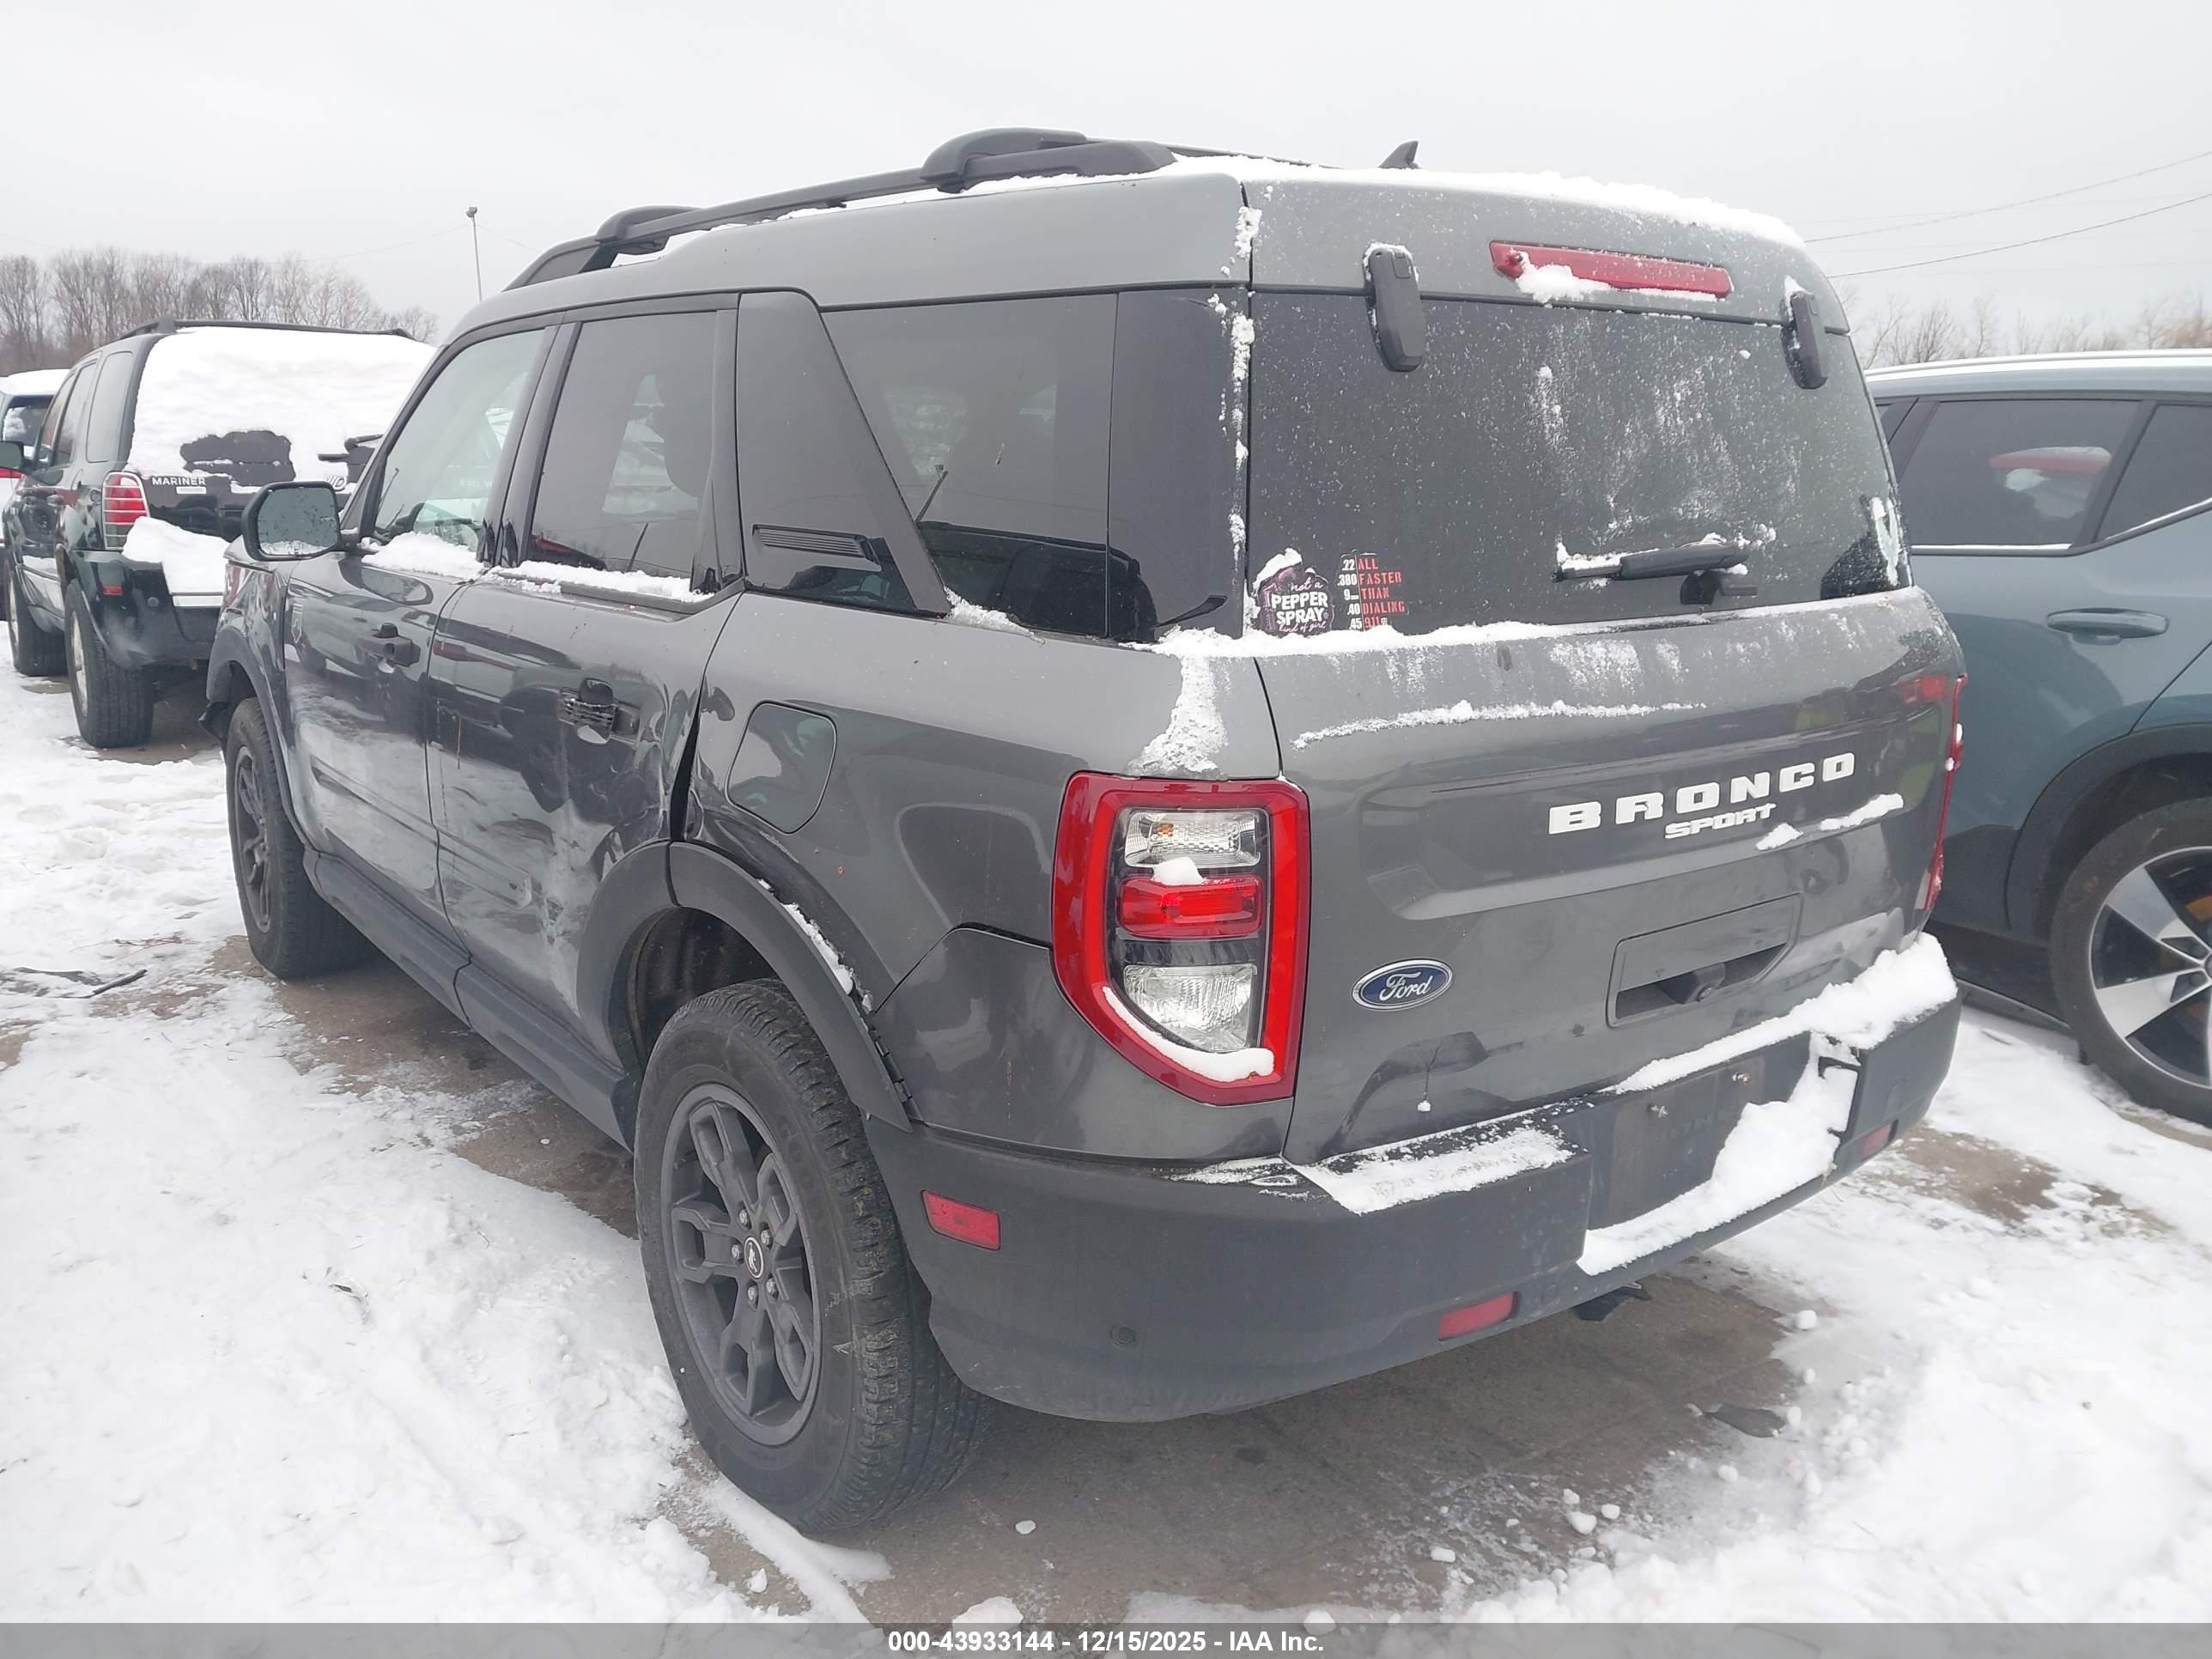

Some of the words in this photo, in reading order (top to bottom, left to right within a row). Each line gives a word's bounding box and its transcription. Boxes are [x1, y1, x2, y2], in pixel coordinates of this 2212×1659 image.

[152, 477, 206, 486] MARINER
[1341, 559, 1355, 571] .22
[1358, 558, 1378, 570] ALL
[1291, 576, 1312, 592] not
[1337, 574, 1358, 586] .380
[1359, 571, 1402, 586] FASTER
[1361, 586, 1389, 599] THAN
[1271, 591, 1328, 611] PEPPER
[1346, 603, 1361, 616] .40
[1363, 601, 1406, 615] DIALING
[1276, 607, 1324, 626] SPRAY
[1348, 617, 1363, 629] .45
[1279, 623, 1298, 633] kind
[1300, 623, 1310, 633] of
[1309, 621, 1327, 632] girl
[1548, 752, 1856, 835] BRONCO
[1665, 802, 1777, 839] SPORT
[1379, 971, 1434, 1001] Ford
